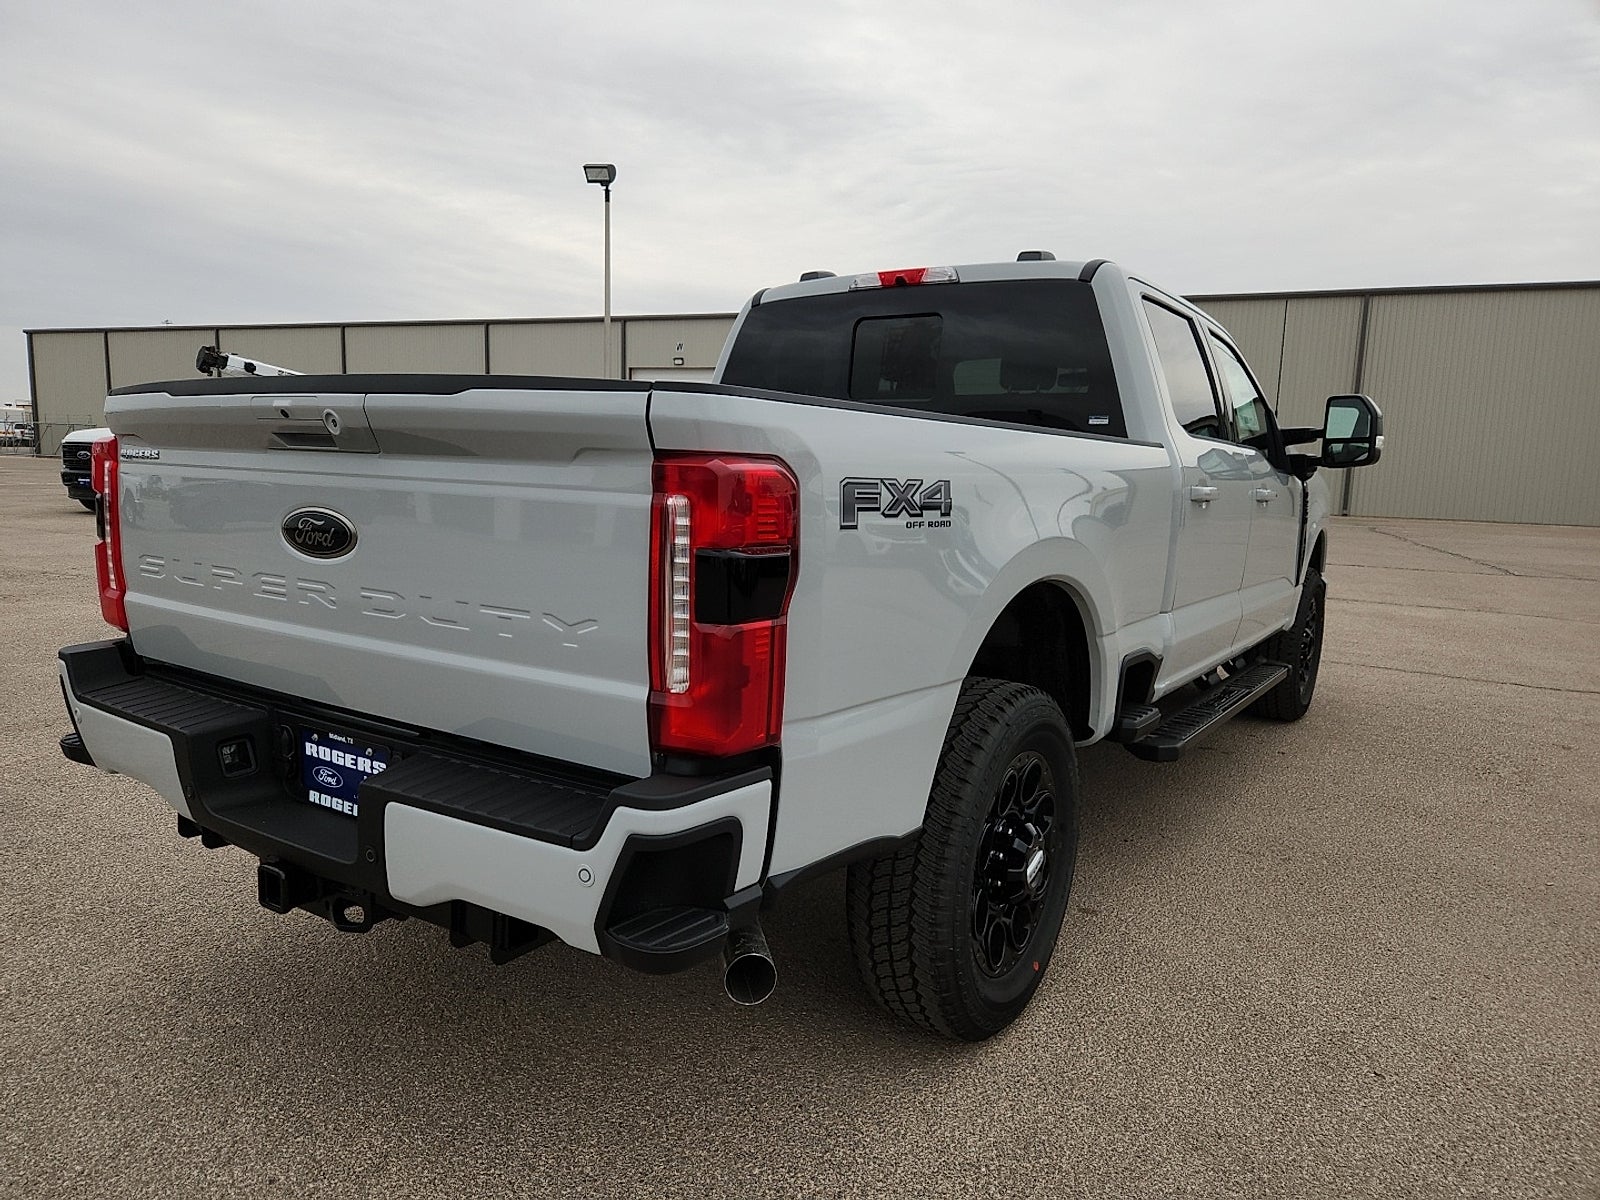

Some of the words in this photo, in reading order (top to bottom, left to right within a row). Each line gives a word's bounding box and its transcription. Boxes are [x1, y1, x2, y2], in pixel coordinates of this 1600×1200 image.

[840, 476, 952, 530] FX4
[294, 517, 336, 547] Ford
[905, 521, 925, 529] OFF
[927, 520, 952, 528] ROAD
[138, 553, 337, 609] SUPER
[359, 586, 599, 647] DUTY
[305, 741, 387, 775] ROGERS
[317, 768, 338, 786] Ford
